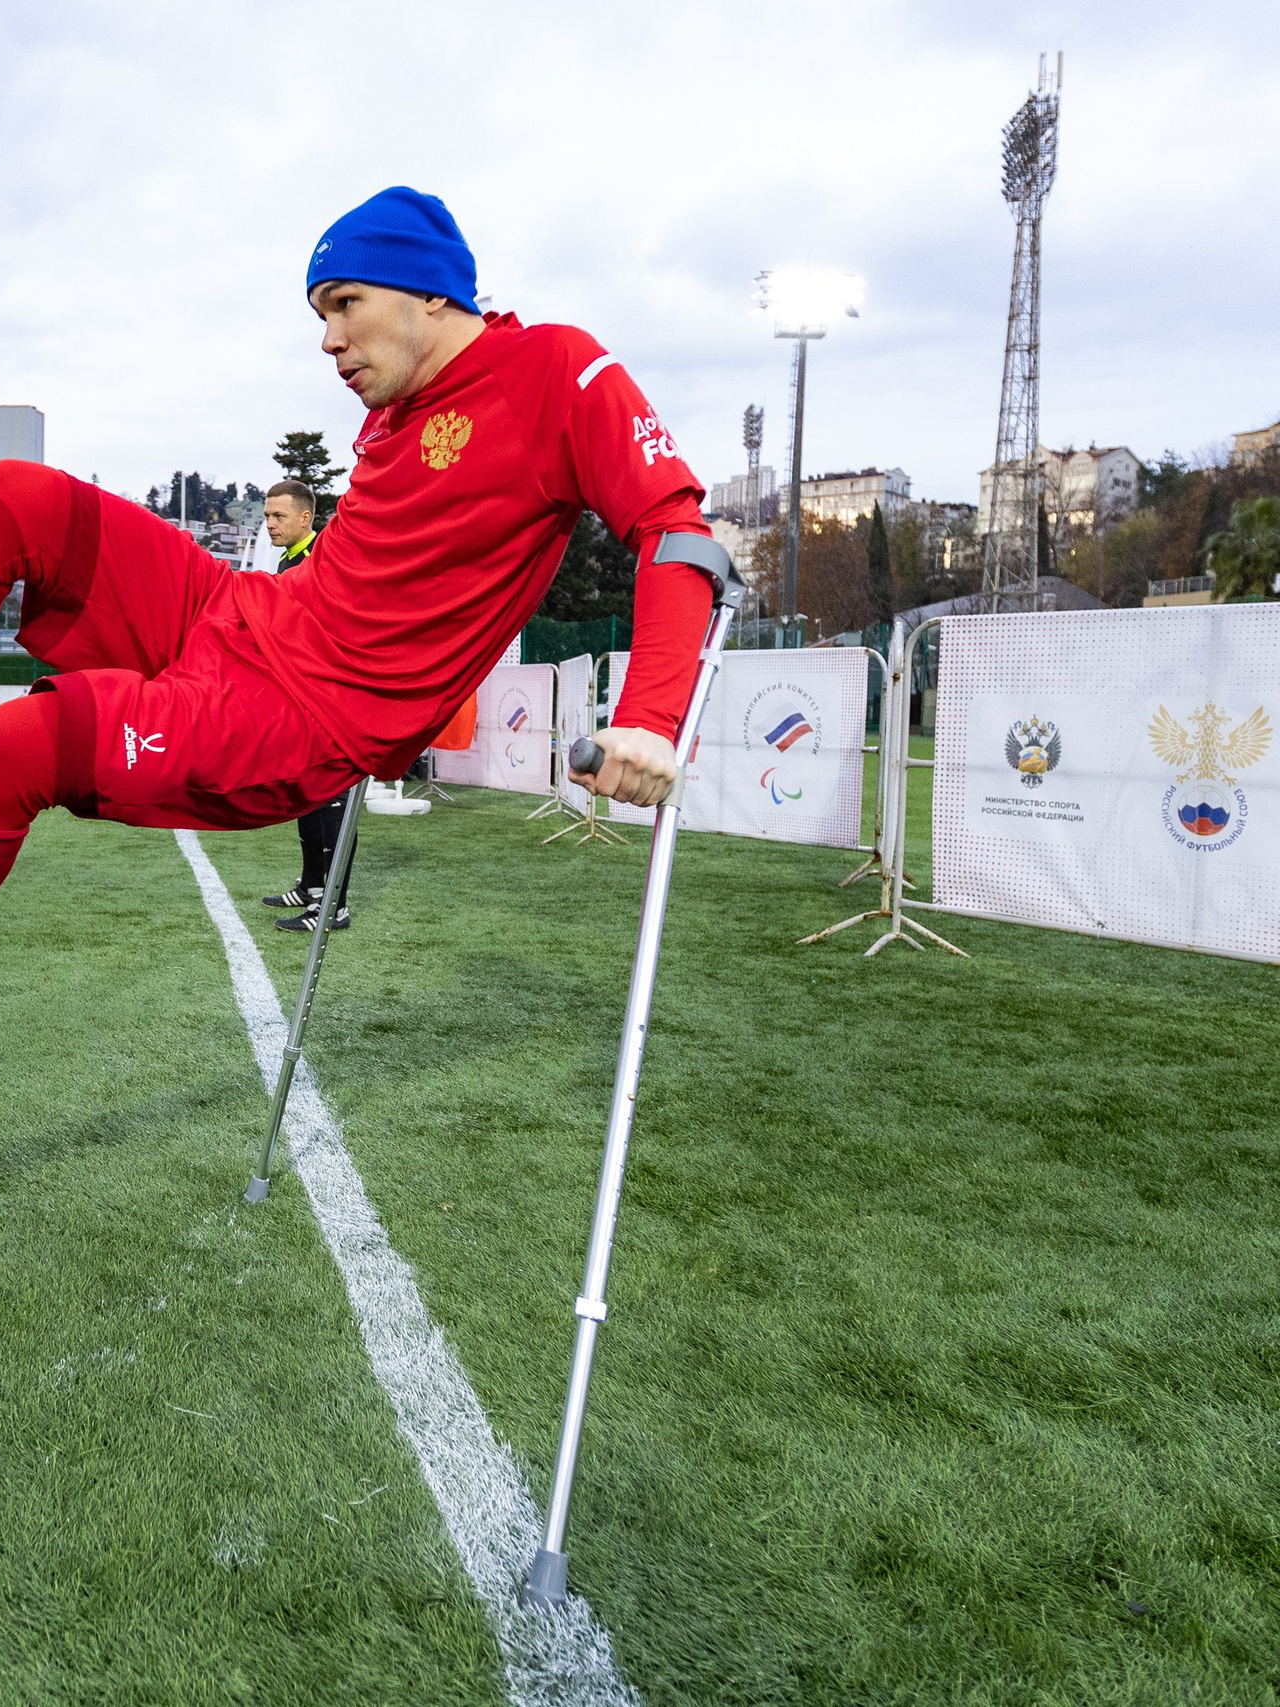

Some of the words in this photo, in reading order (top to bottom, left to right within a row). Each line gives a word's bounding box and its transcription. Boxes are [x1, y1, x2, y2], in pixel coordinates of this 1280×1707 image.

[743, 681, 782, 751] ПАРАЛИМПИЙСКИЙ
[787, 684, 819, 712] КОМИТЕТ
[811, 716, 822, 755] РОССИИ
[981, 806, 1033, 818] РОССИЙСКОЙ
[1035, 812, 1084, 822] ФЕДЕРАЦИИ
[985, 796, 1047, 808] МИНИСТЕРСТВО
[1048, 801, 1081, 810] СПОРТА
[1161, 784, 1186, 845] РОССИЙСКИЙ
[1186, 819, 1247, 852] ФУТБОЛЬНЫЙ
[1233, 788, 1248, 817] СОЮЗ
